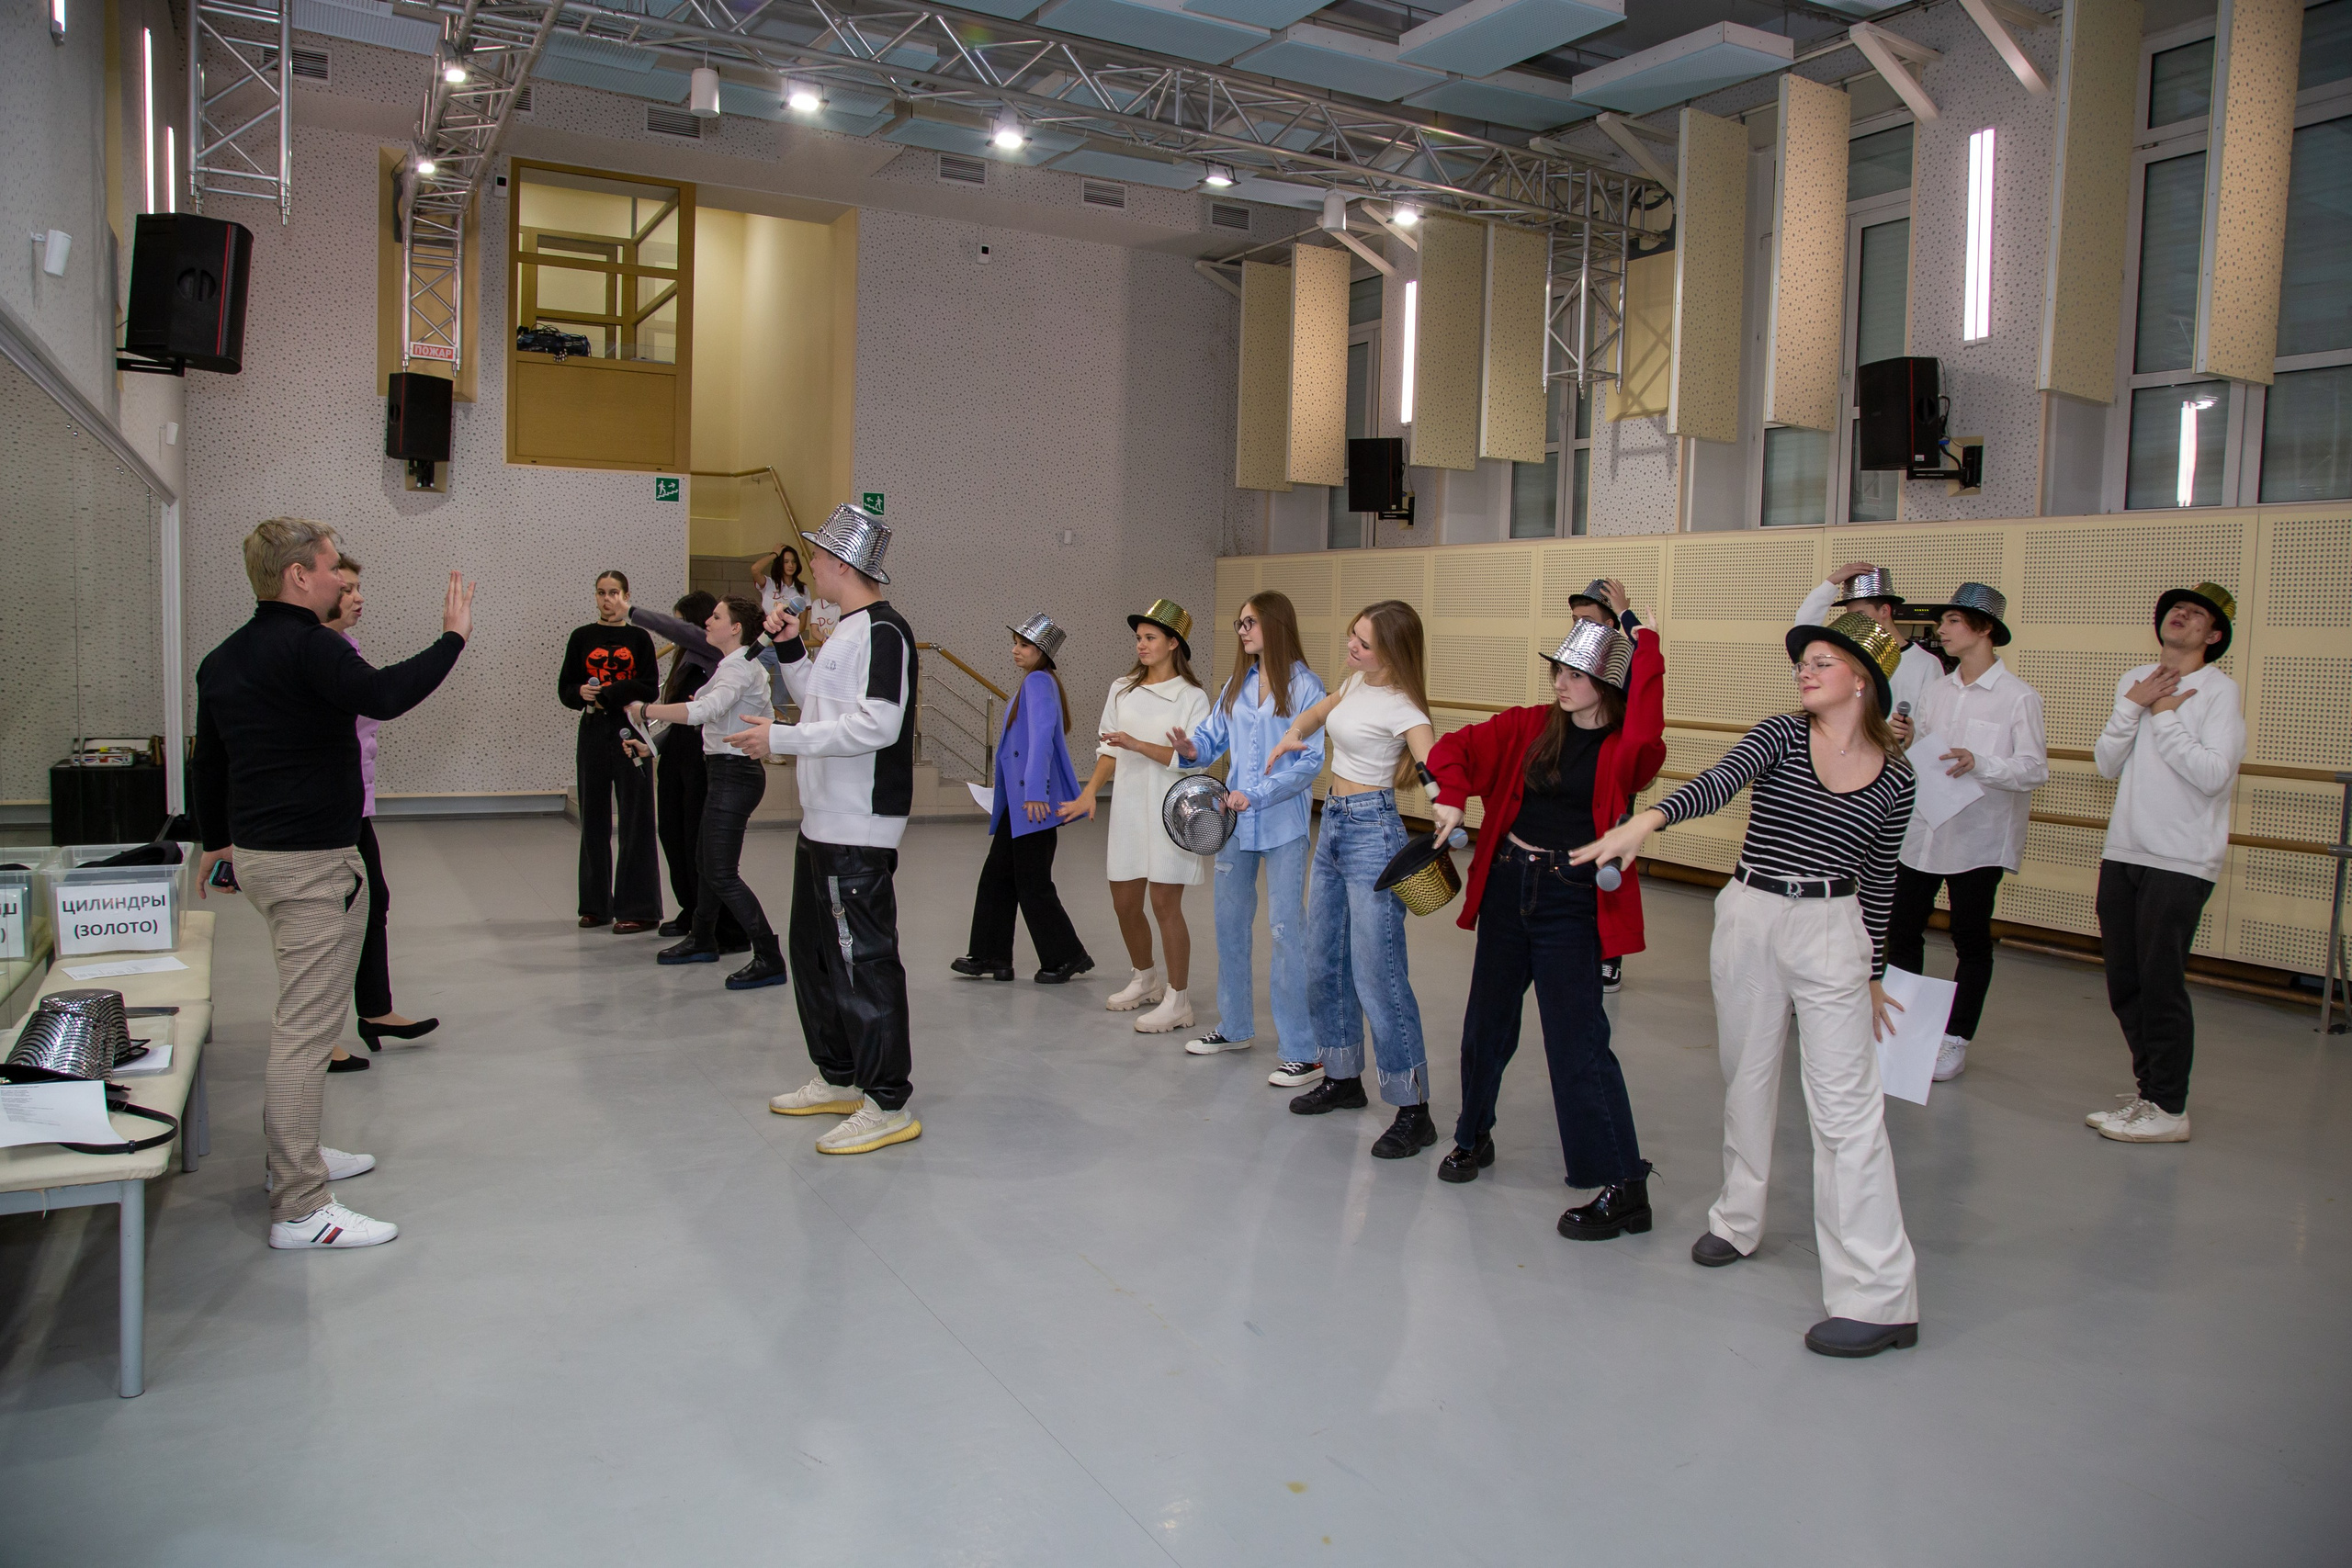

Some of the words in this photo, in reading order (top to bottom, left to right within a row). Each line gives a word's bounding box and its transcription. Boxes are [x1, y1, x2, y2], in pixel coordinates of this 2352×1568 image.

[414, 344, 452, 358] ПОЖАР
[62, 894, 165, 915] ЦИЛИНДРЫ
[74, 919, 158, 940] (ЗОЛОТО)
